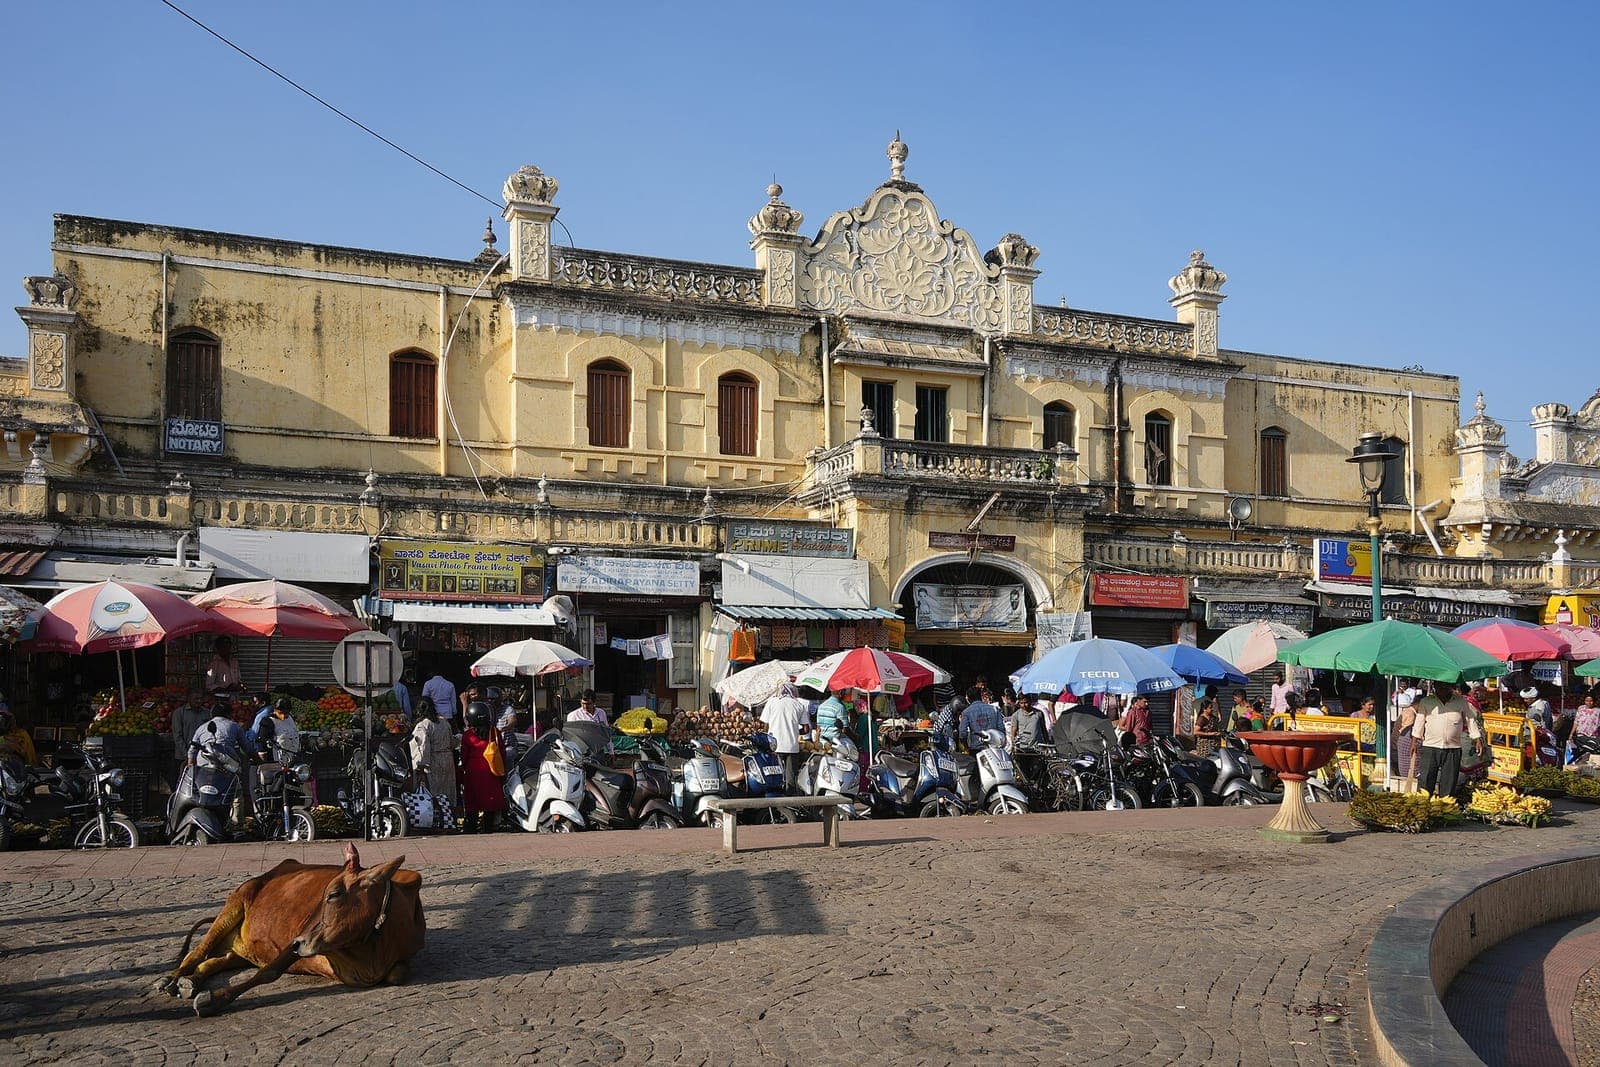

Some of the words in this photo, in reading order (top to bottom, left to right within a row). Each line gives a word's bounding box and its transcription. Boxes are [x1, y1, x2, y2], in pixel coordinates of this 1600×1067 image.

[168, 437, 221, 452] NOTARY
[731, 539, 788, 553] PRIME
[1321, 541, 1338, 555] DH
[411, 560, 438, 569] Vasavi
[440, 561, 461, 570] Photo
[464, 562, 489, 570] Frame
[491, 563, 514, 572] Works
[592, 577, 666, 587] ADINARAYANA
[668, 579, 695, 588] SETTY
[1413, 601, 1511, 618] GOWRISHANKAR
[1080, 671, 1120, 679] TECNO
[1532, 669, 1561, 679] SWEETS
